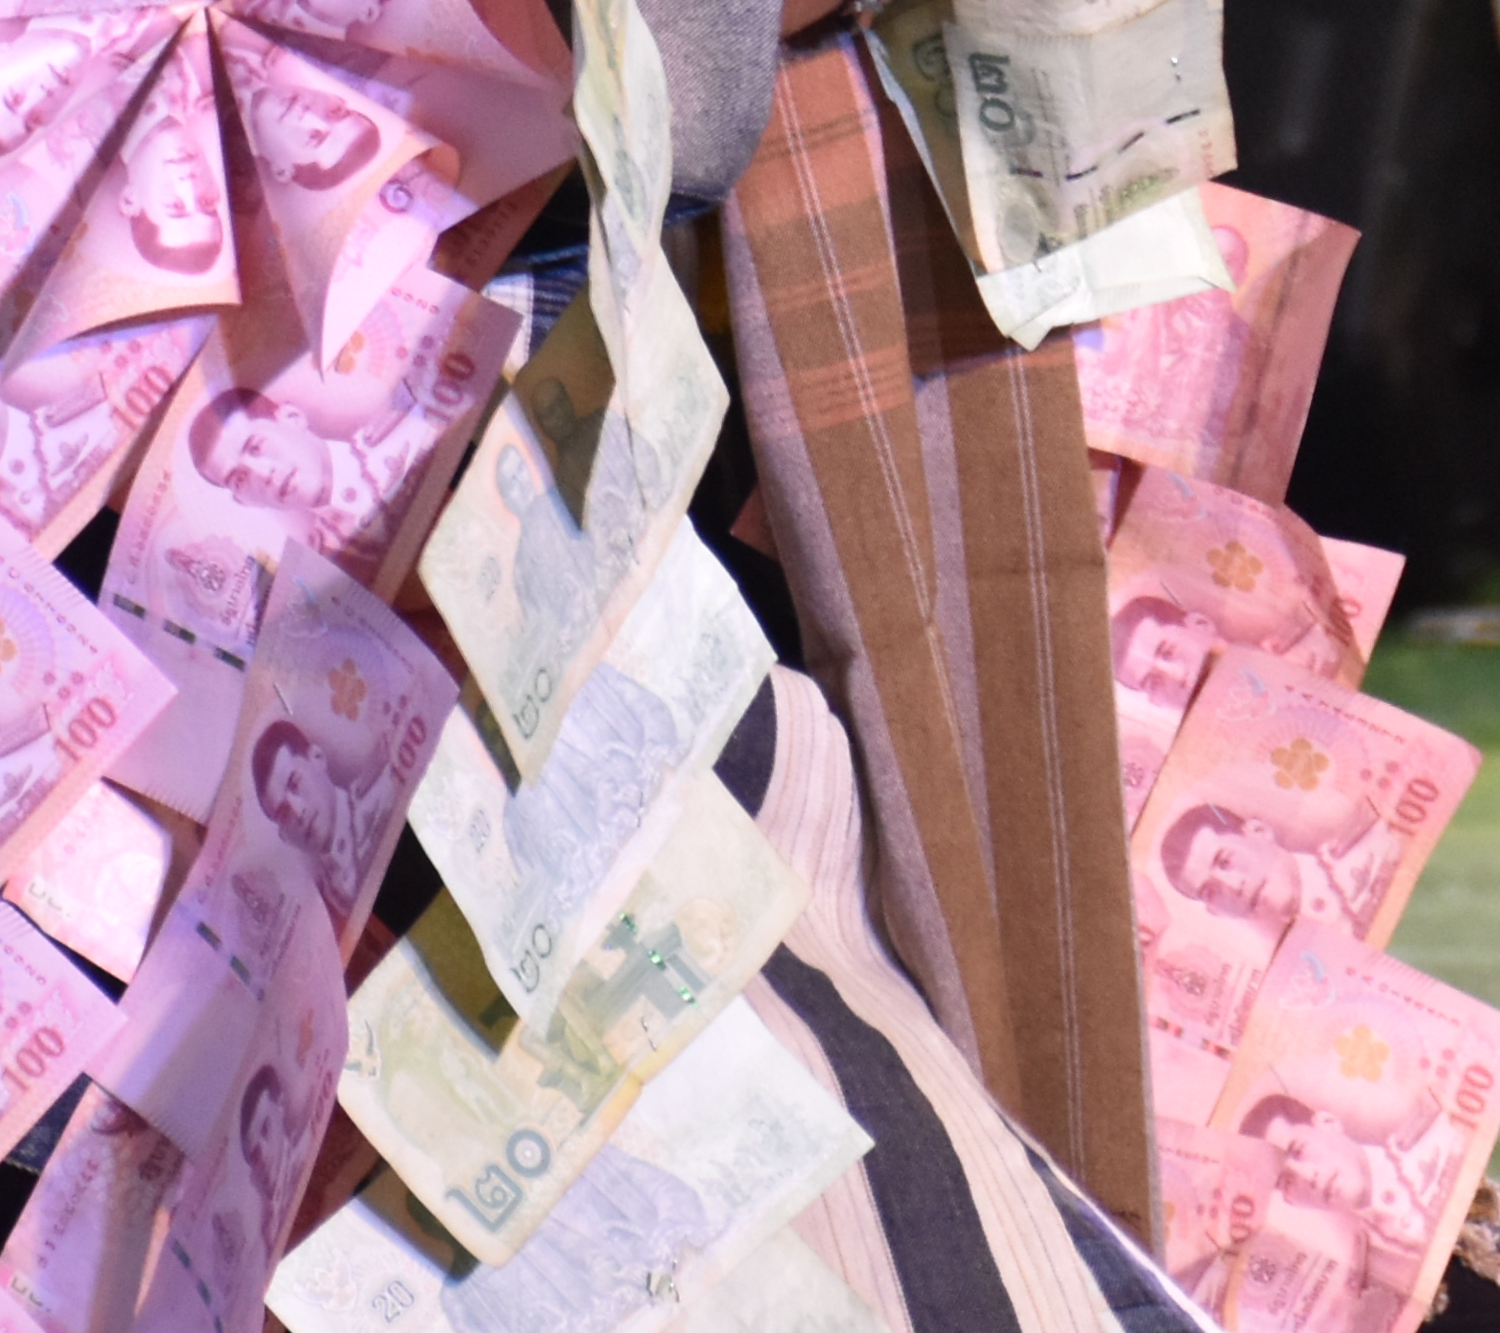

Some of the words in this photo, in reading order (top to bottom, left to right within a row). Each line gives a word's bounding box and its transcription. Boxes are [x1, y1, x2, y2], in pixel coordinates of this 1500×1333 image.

[111, 364, 176, 433] 100
[51, 695, 119, 766] 100
[1385, 776, 1441, 841] 100
[0, 1024, 65, 1094] 100
[1447, 1062, 1497, 1134] 100
[446, 1127, 552, 1234] ๒๐
[371, 1279, 416, 1324] 20
